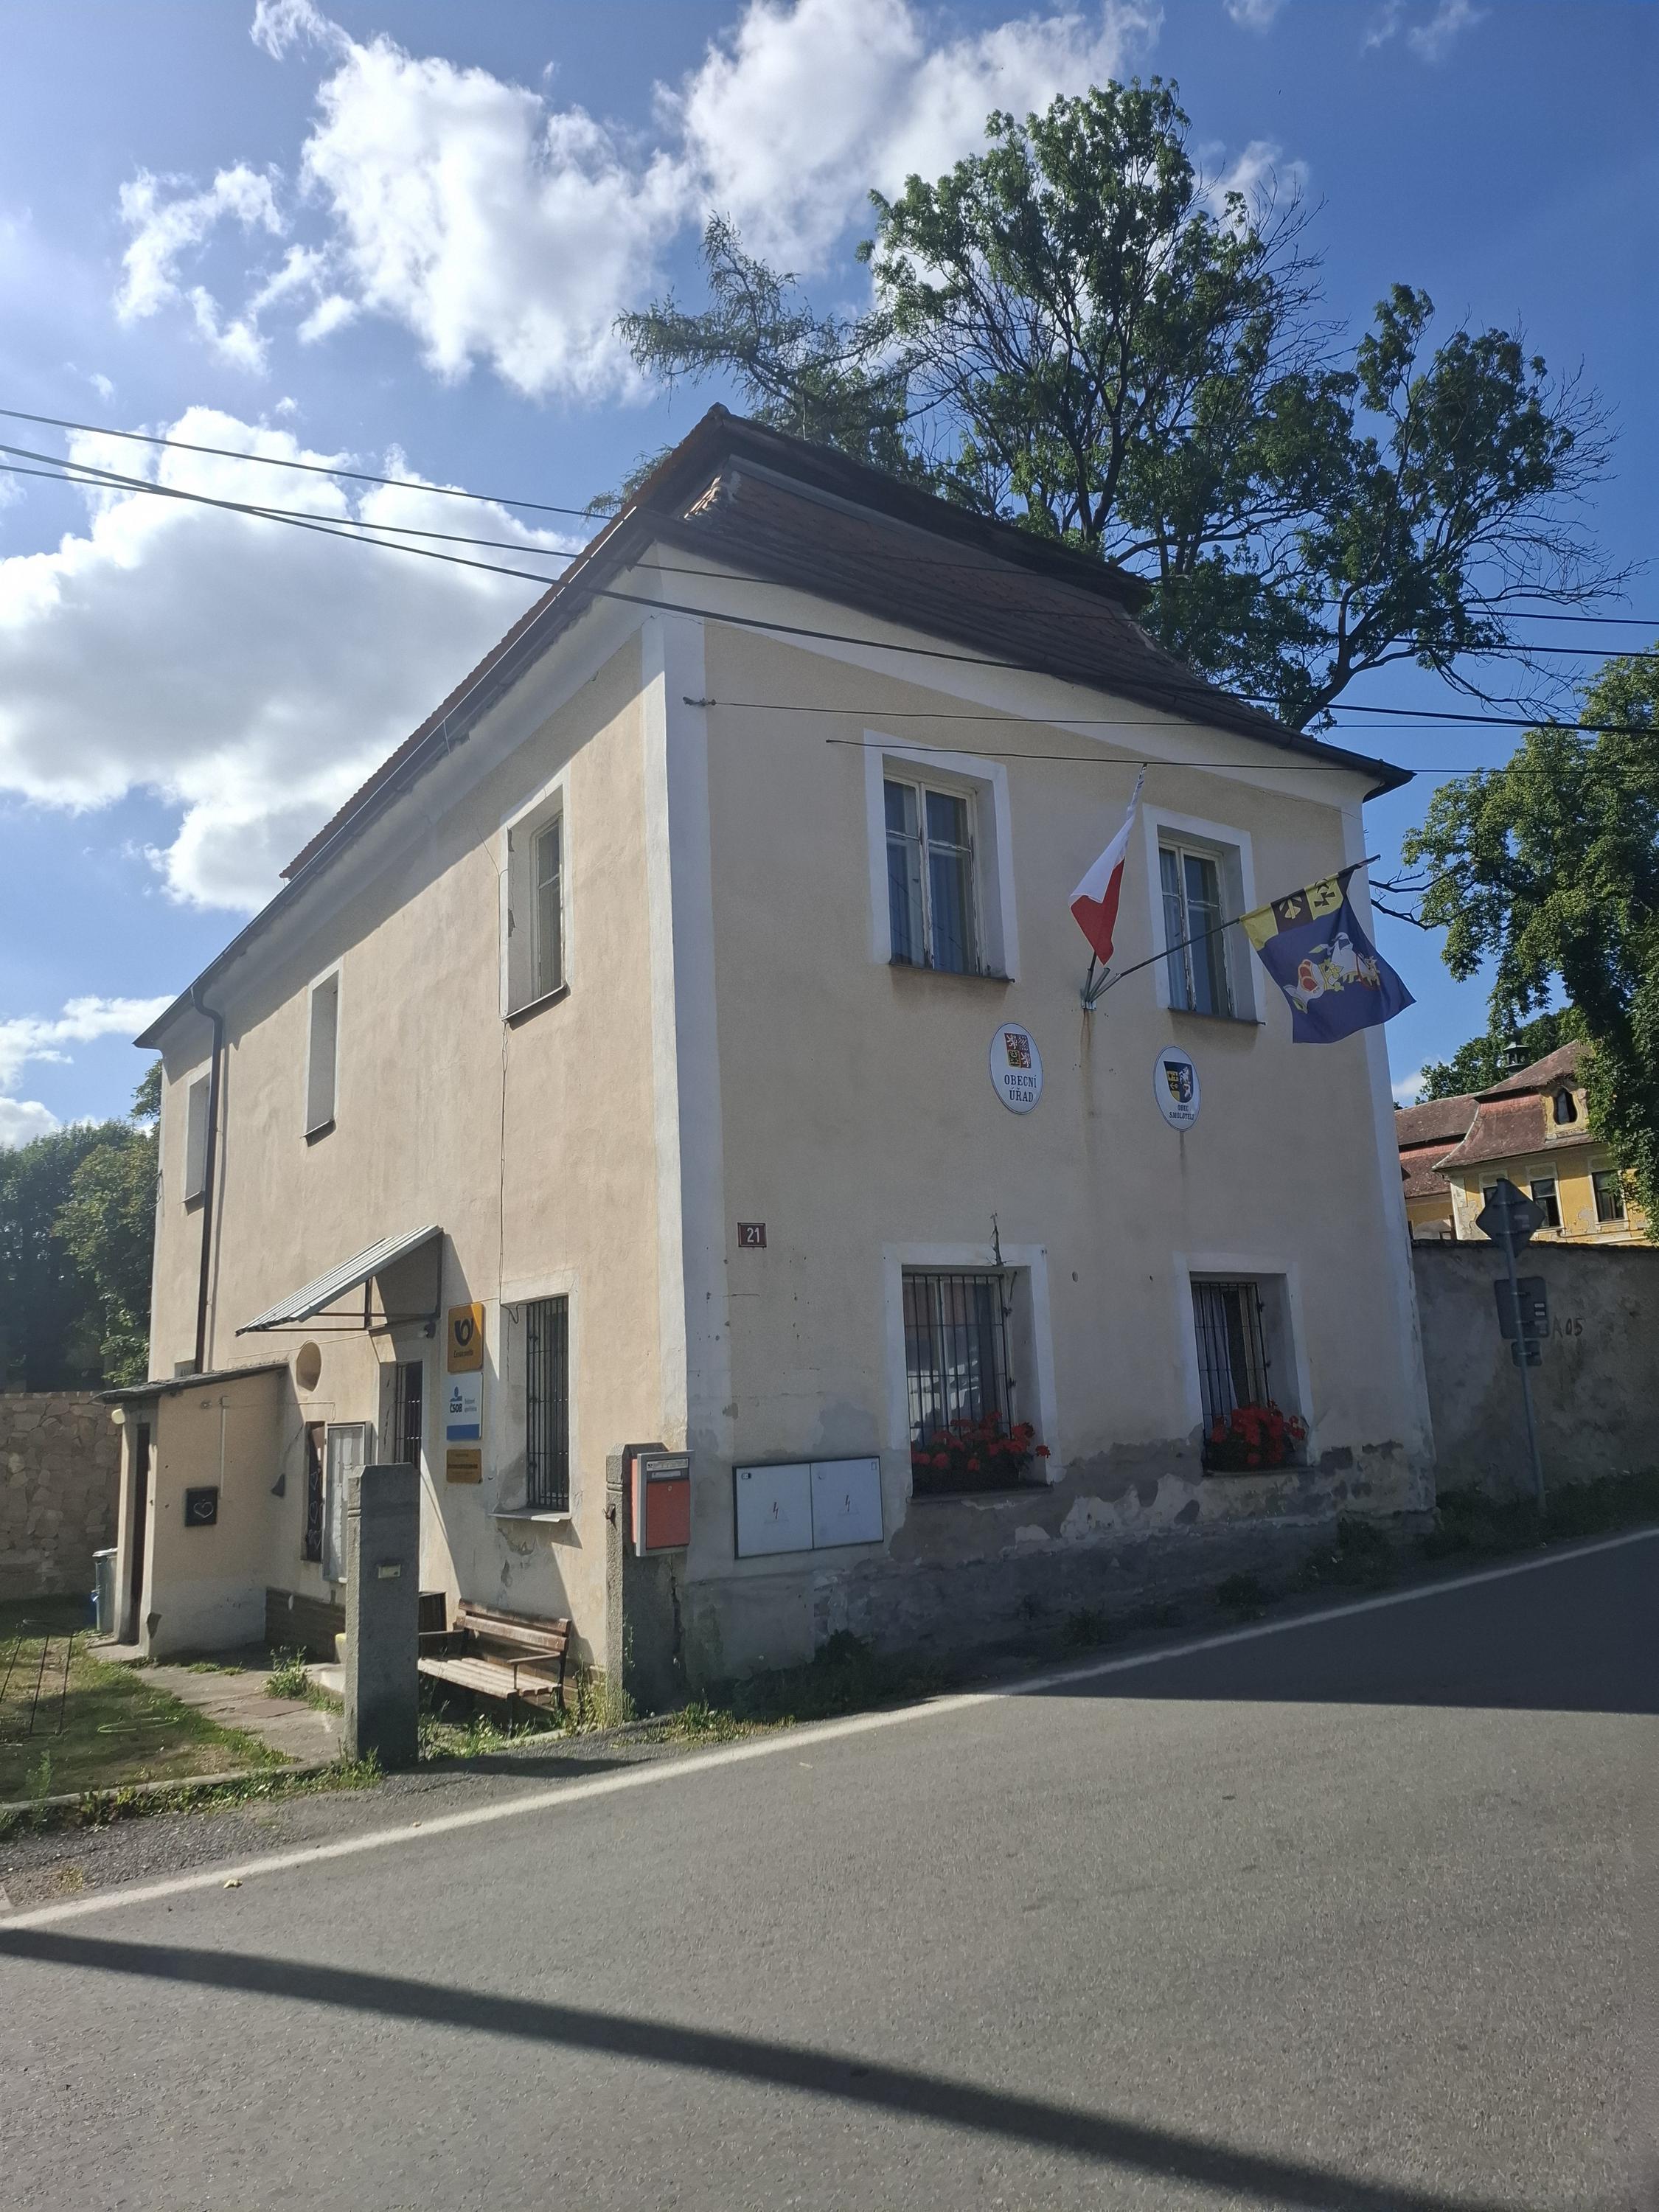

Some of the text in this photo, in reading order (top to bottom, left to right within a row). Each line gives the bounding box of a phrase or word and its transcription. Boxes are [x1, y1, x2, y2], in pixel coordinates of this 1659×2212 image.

[1004, 1074, 1037, 1088] OBECNÍ
[1009, 1087, 1034, 1102] ÚŘAD
[1178, 1104, 1189, 1112] OBEC
[747, 1227, 759, 1243] 21
